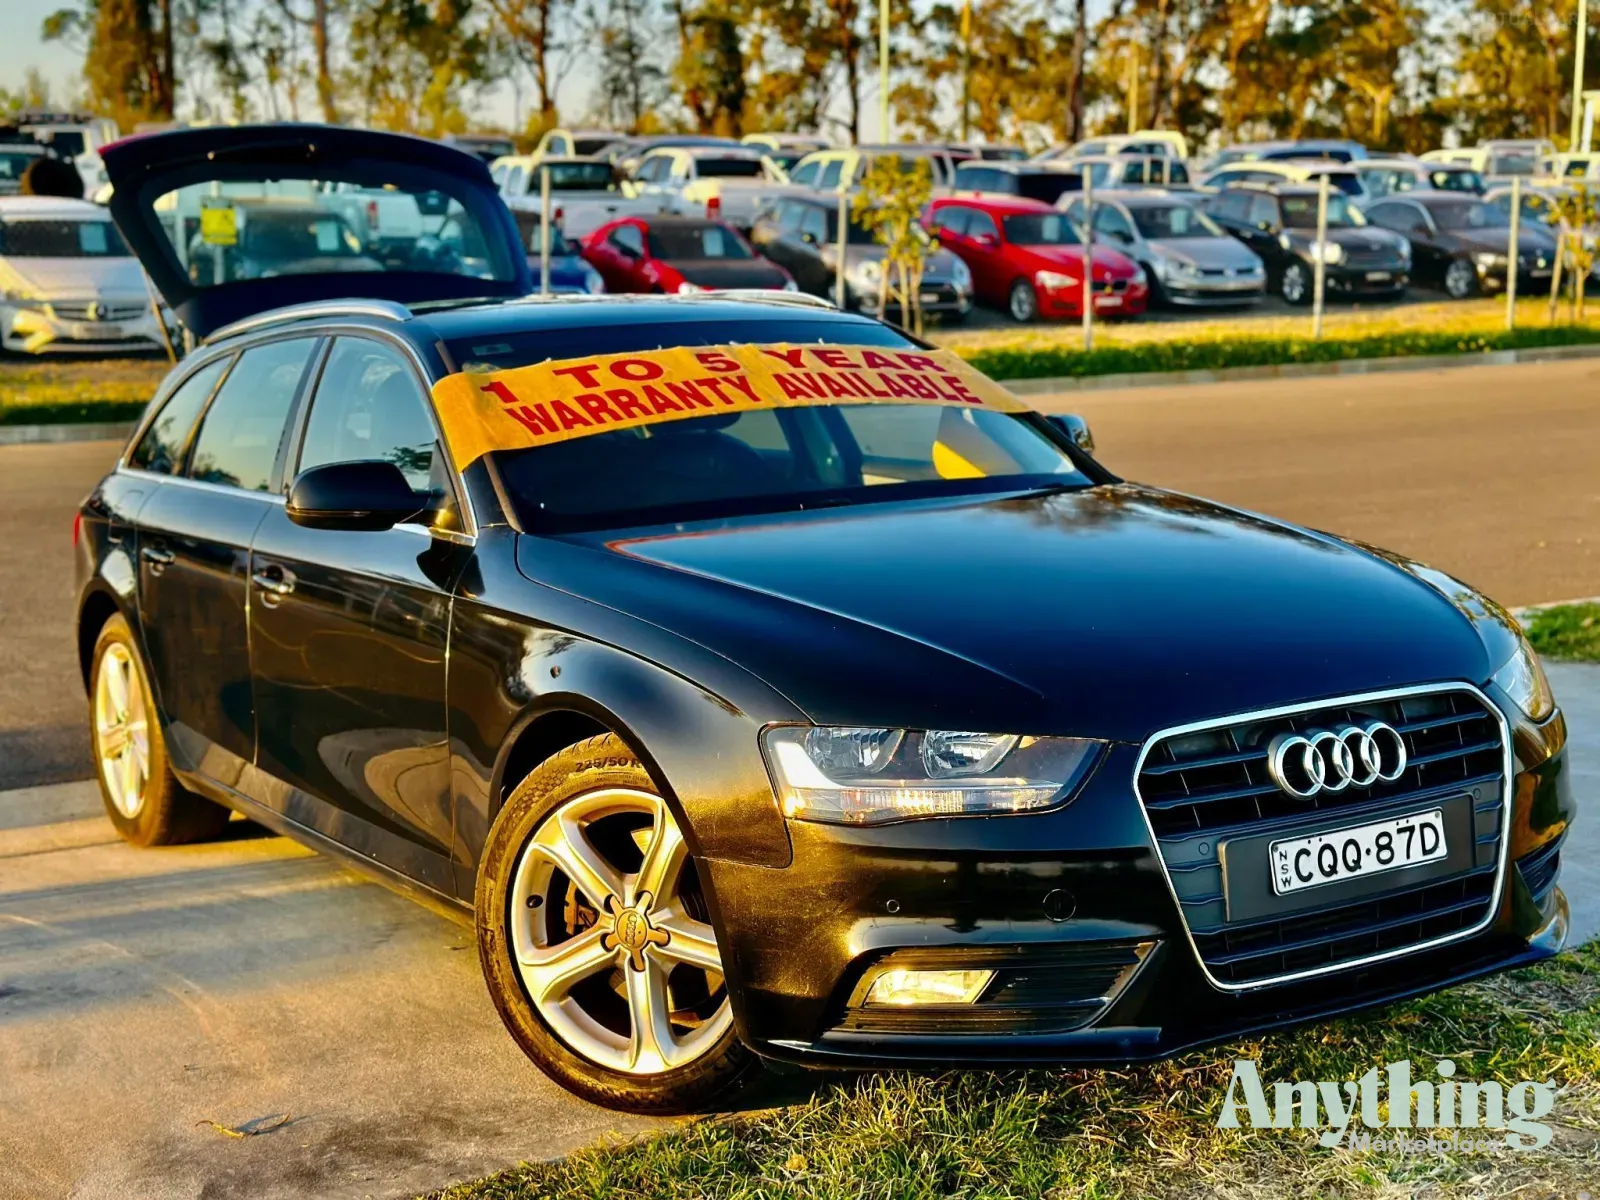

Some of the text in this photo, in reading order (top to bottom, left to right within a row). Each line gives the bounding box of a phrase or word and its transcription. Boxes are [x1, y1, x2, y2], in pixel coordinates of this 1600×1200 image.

[480, 349, 946, 404] 1 TO 5 YEAR
[504, 372, 984, 436] WARRANTY AVAILABLE
